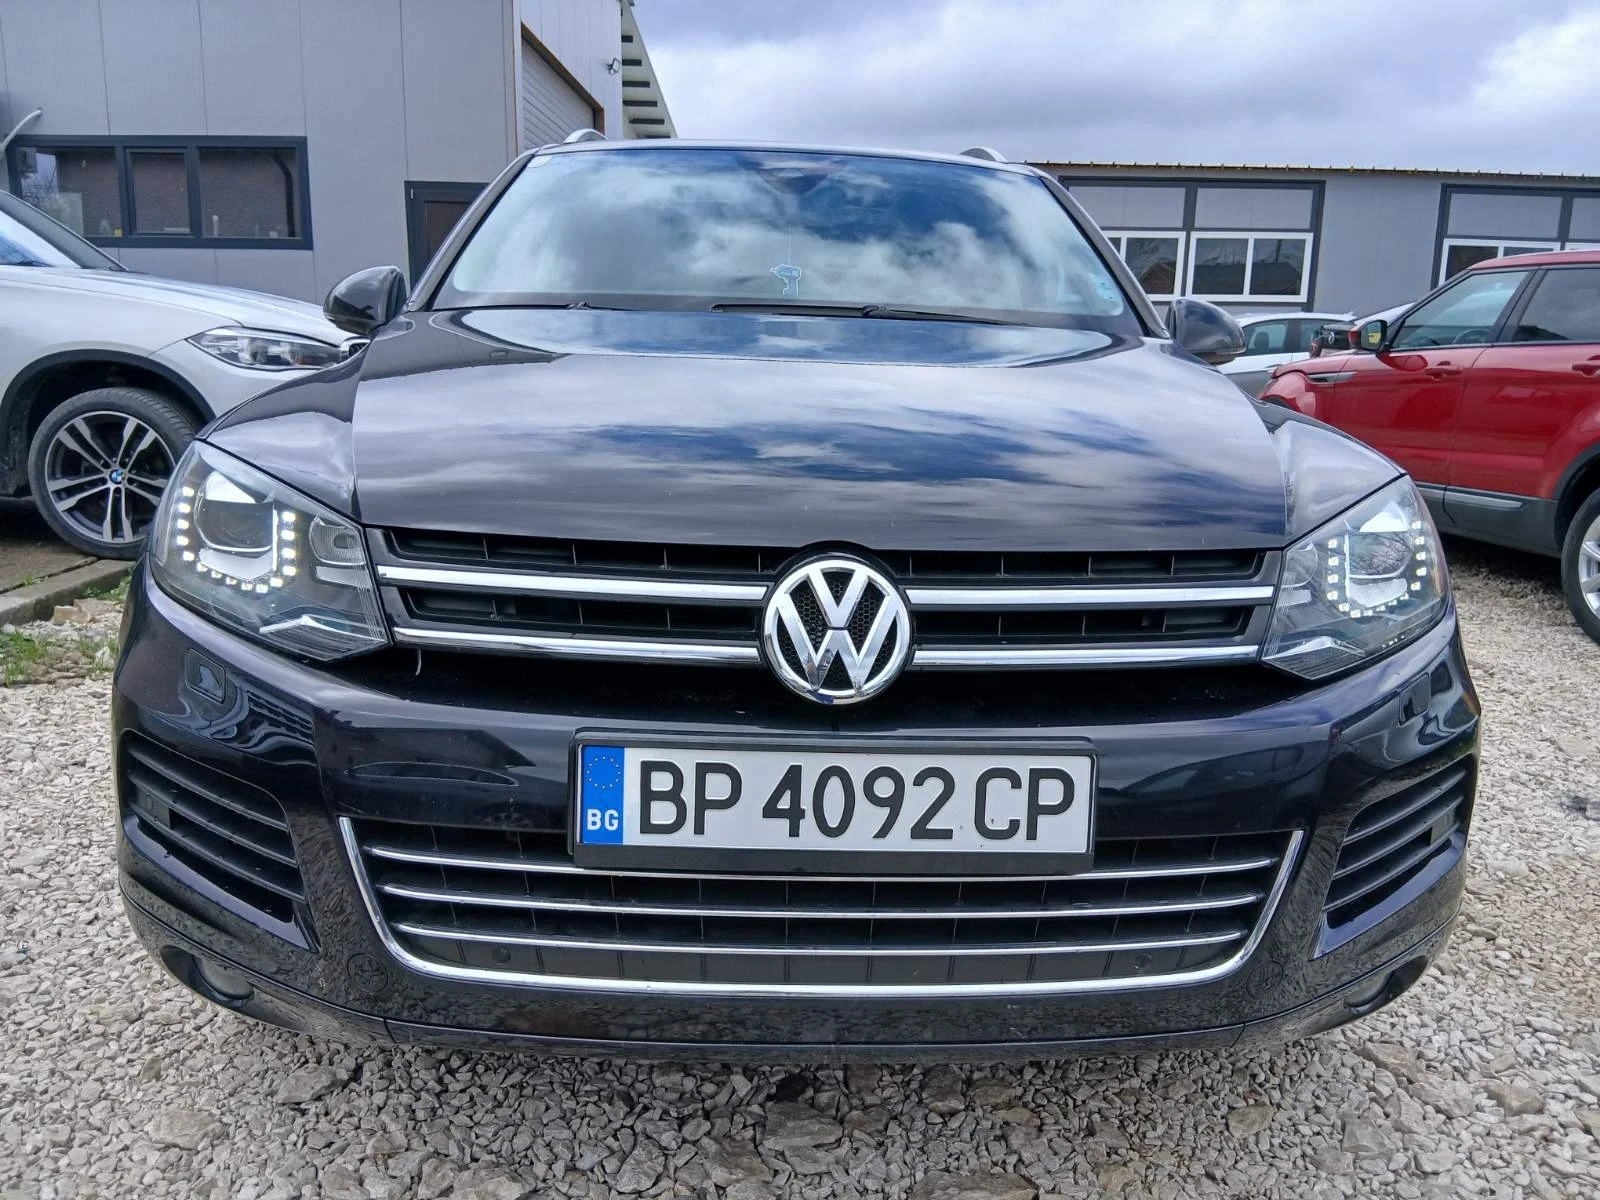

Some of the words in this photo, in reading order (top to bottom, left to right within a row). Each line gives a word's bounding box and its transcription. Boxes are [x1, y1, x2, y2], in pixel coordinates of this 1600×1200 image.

[586, 808, 619, 832] BG
[639, 759, 742, 836] BP
[762, 764, 955, 840] 4092
[974, 767, 1075, 841] CP
